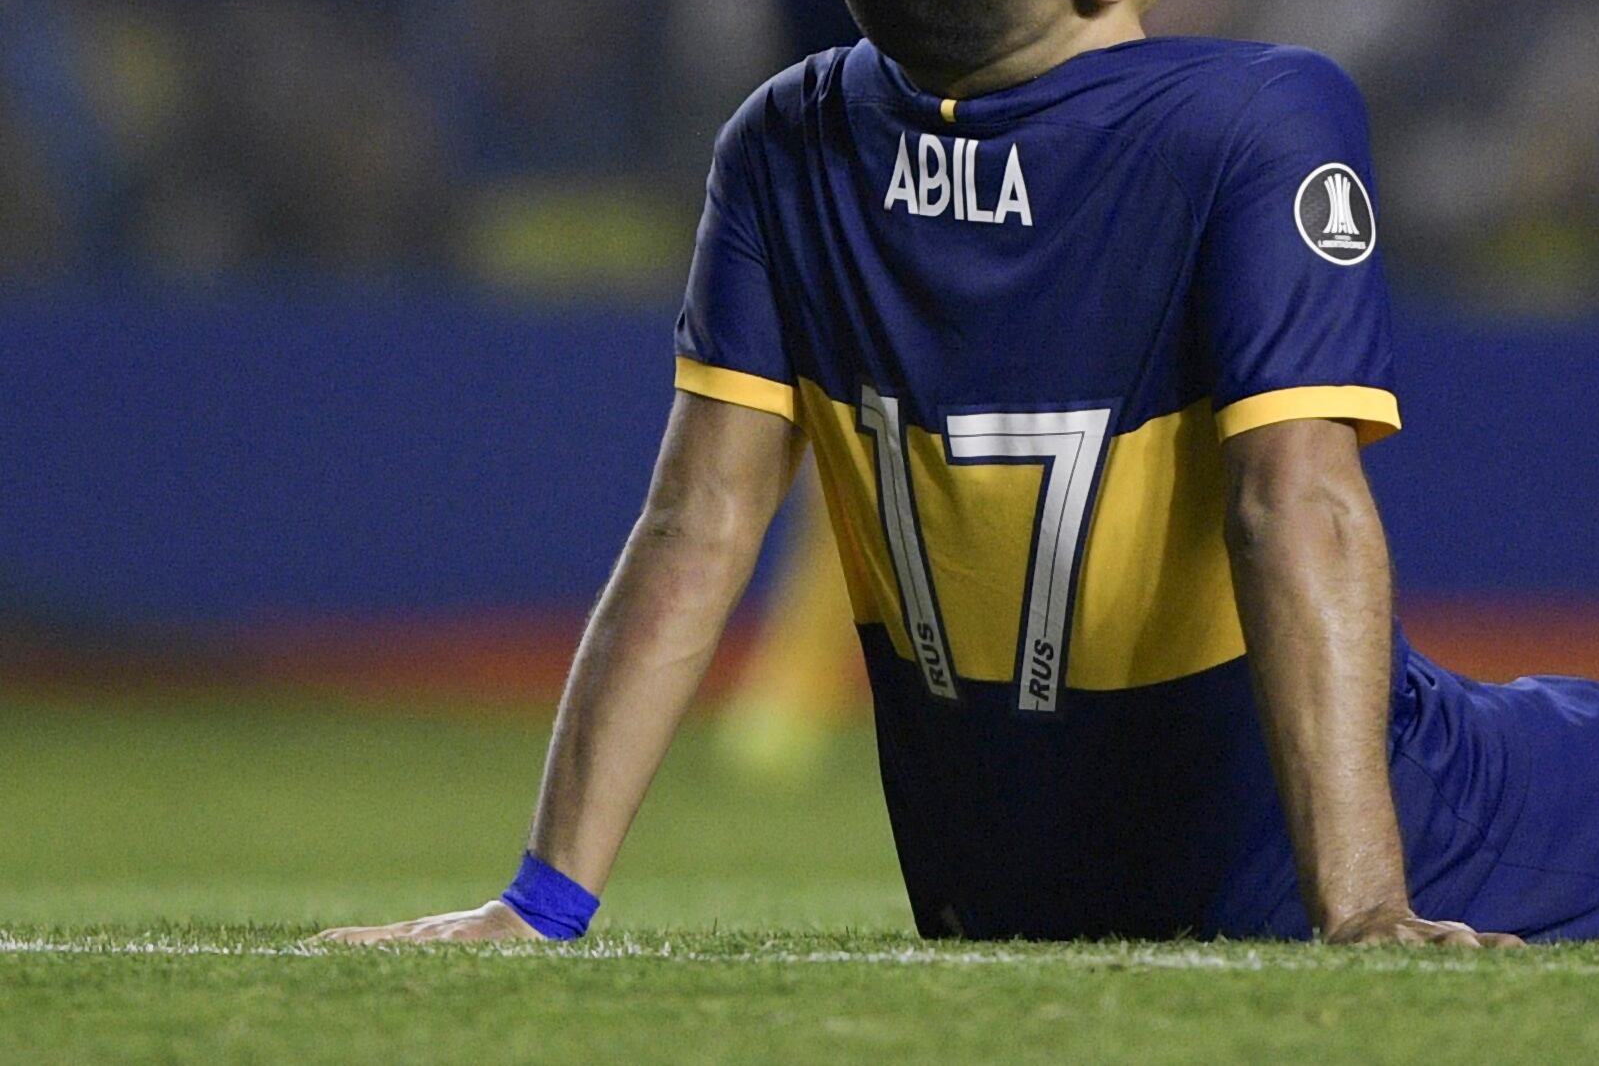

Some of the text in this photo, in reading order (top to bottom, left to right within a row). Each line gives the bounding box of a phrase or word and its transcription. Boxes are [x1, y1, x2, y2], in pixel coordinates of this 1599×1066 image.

[884, 131, 1033, 226] ABILA
[860, 384, 1112, 713] 17
[916, 620, 949, 689] RUS
[1028, 638, 1055, 702] RUS
